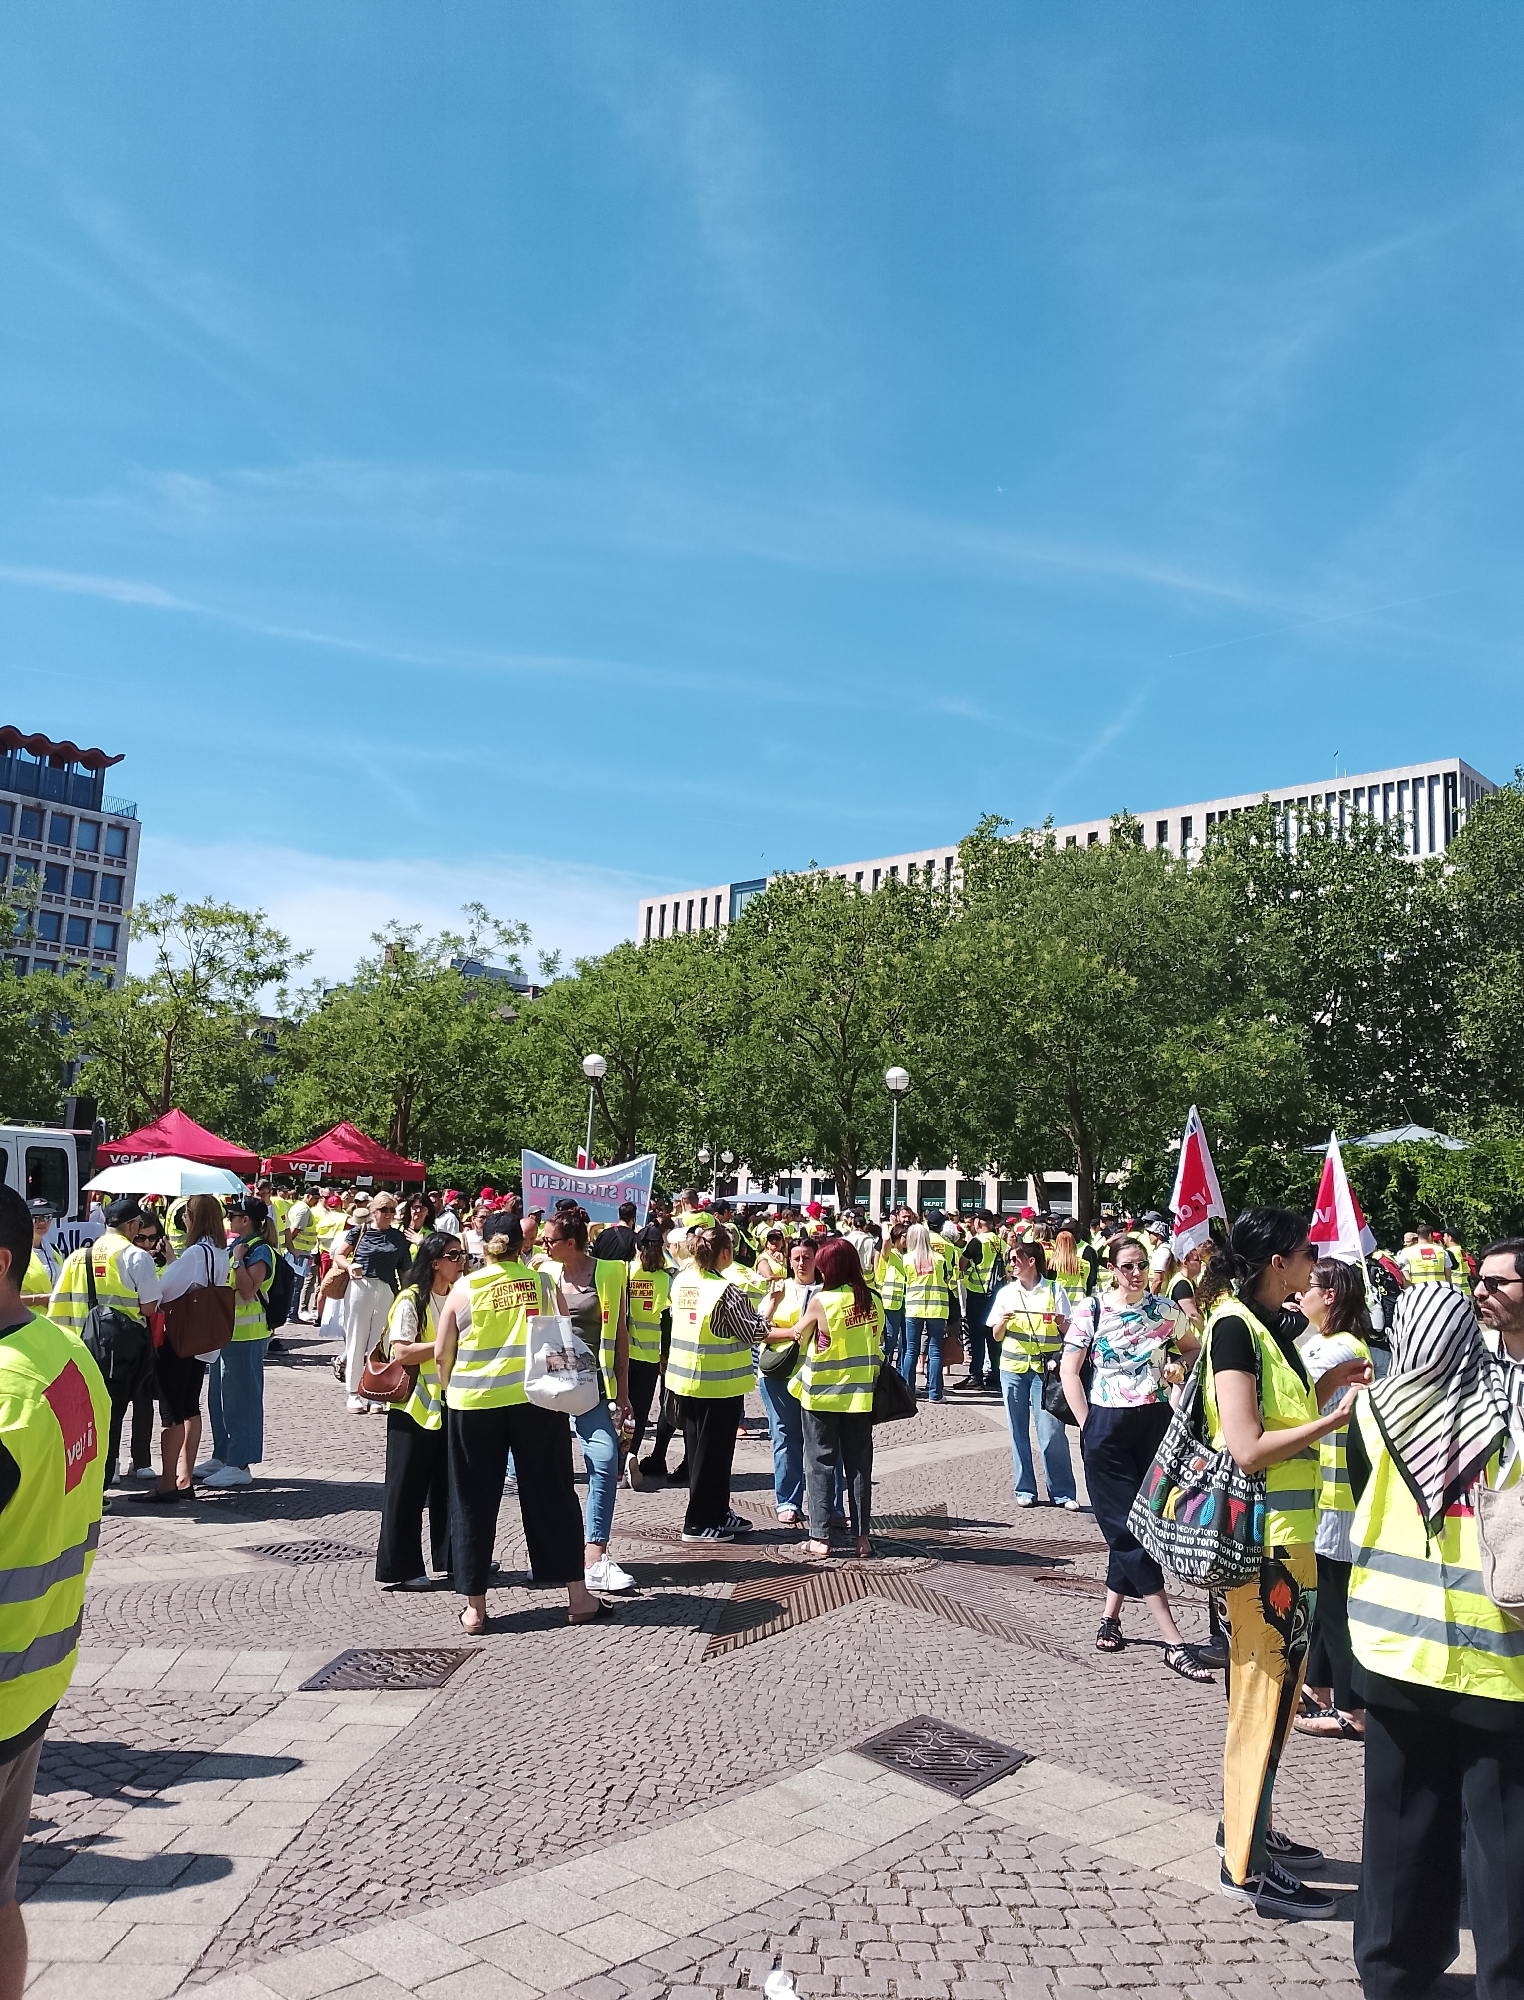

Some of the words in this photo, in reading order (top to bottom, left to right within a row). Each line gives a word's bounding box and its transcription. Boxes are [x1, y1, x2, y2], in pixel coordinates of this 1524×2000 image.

[110, 1152, 157, 1164] verdi
[289, 1161, 332, 1174] verdi
[341, 1168, 361, 1177] Bezirk
[364, 1170, 400, 1178] Wiesbaden
[492, 1281, 536, 1299] ZUSAMMEN
[629, 1281, 654, 1290] USAMMEN
[493, 1295, 514, 1309] GEHT
[515, 1292, 538, 1304] MEHR
